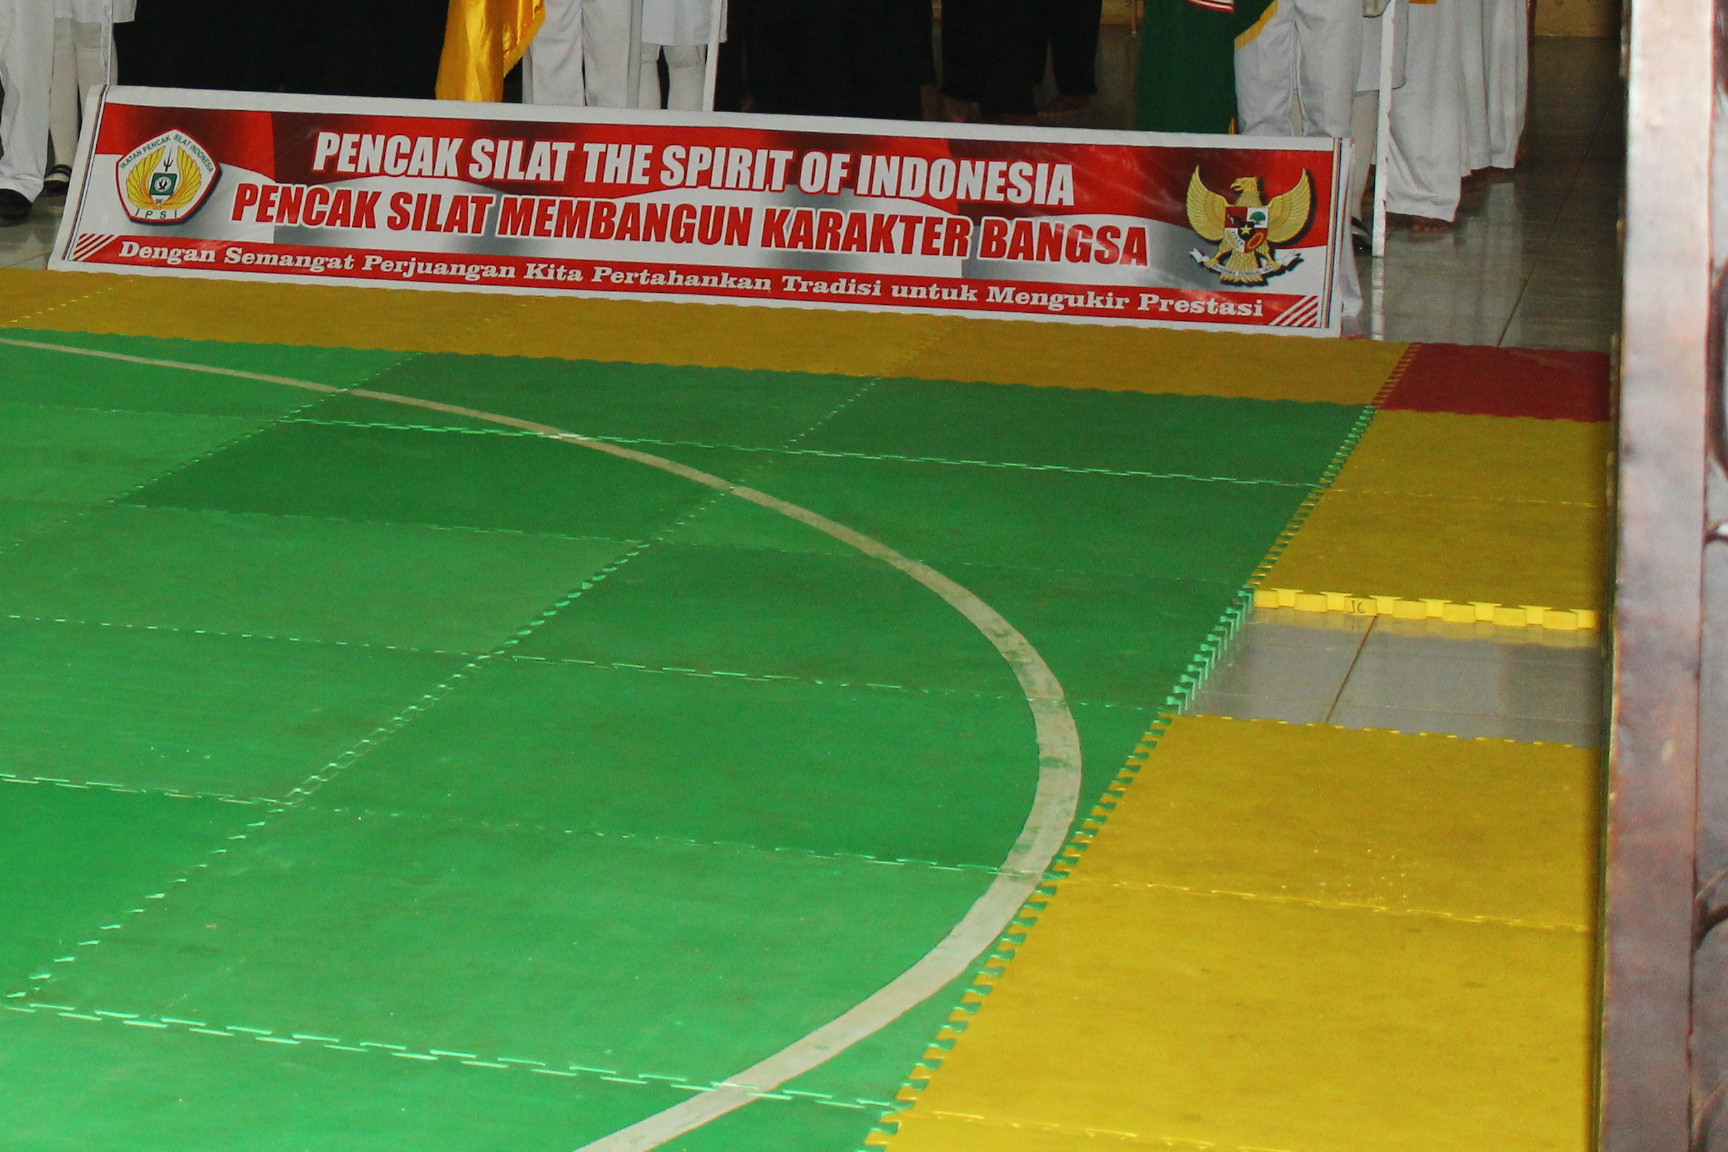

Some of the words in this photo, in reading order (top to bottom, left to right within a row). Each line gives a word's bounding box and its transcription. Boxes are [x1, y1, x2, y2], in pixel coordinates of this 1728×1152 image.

[120, 151, 142, 169] IKATAN
[142, 135, 171, 153] PENCAK
[174, 134, 192, 148] SILAT
[189, 144, 215, 173] INDONESIA
[312, 131, 464, 178] PENCAK
[468, 138, 575, 182] SILAT
[582, 142, 654, 186] THE
[660, 145, 794, 192] SPIRIT
[800, 151, 851, 194] OF
[856, 154, 1075, 206] INDONESIA
[232, 182, 382, 229] PENCAK
[386, 192, 494, 234] SILAT
[498, 196, 753, 246] MEMBANGUN
[760, 207, 972, 257] KARAKTER
[978, 218, 1149, 267] BANGSA
[118, 240, 216, 264] Dengan
[224, 246, 354, 272] Semangat
[362, 254, 515, 281] Perjuangan
[523, 262, 583, 282] Kita
[591, 266, 772, 291] Pertahankan
[782, 275, 882, 297] Tradisi
[891, 284, 978, 302] untuk
[986, 286, 1130, 312] Mengukir
[1138, 294, 1264, 318] Prestasi
